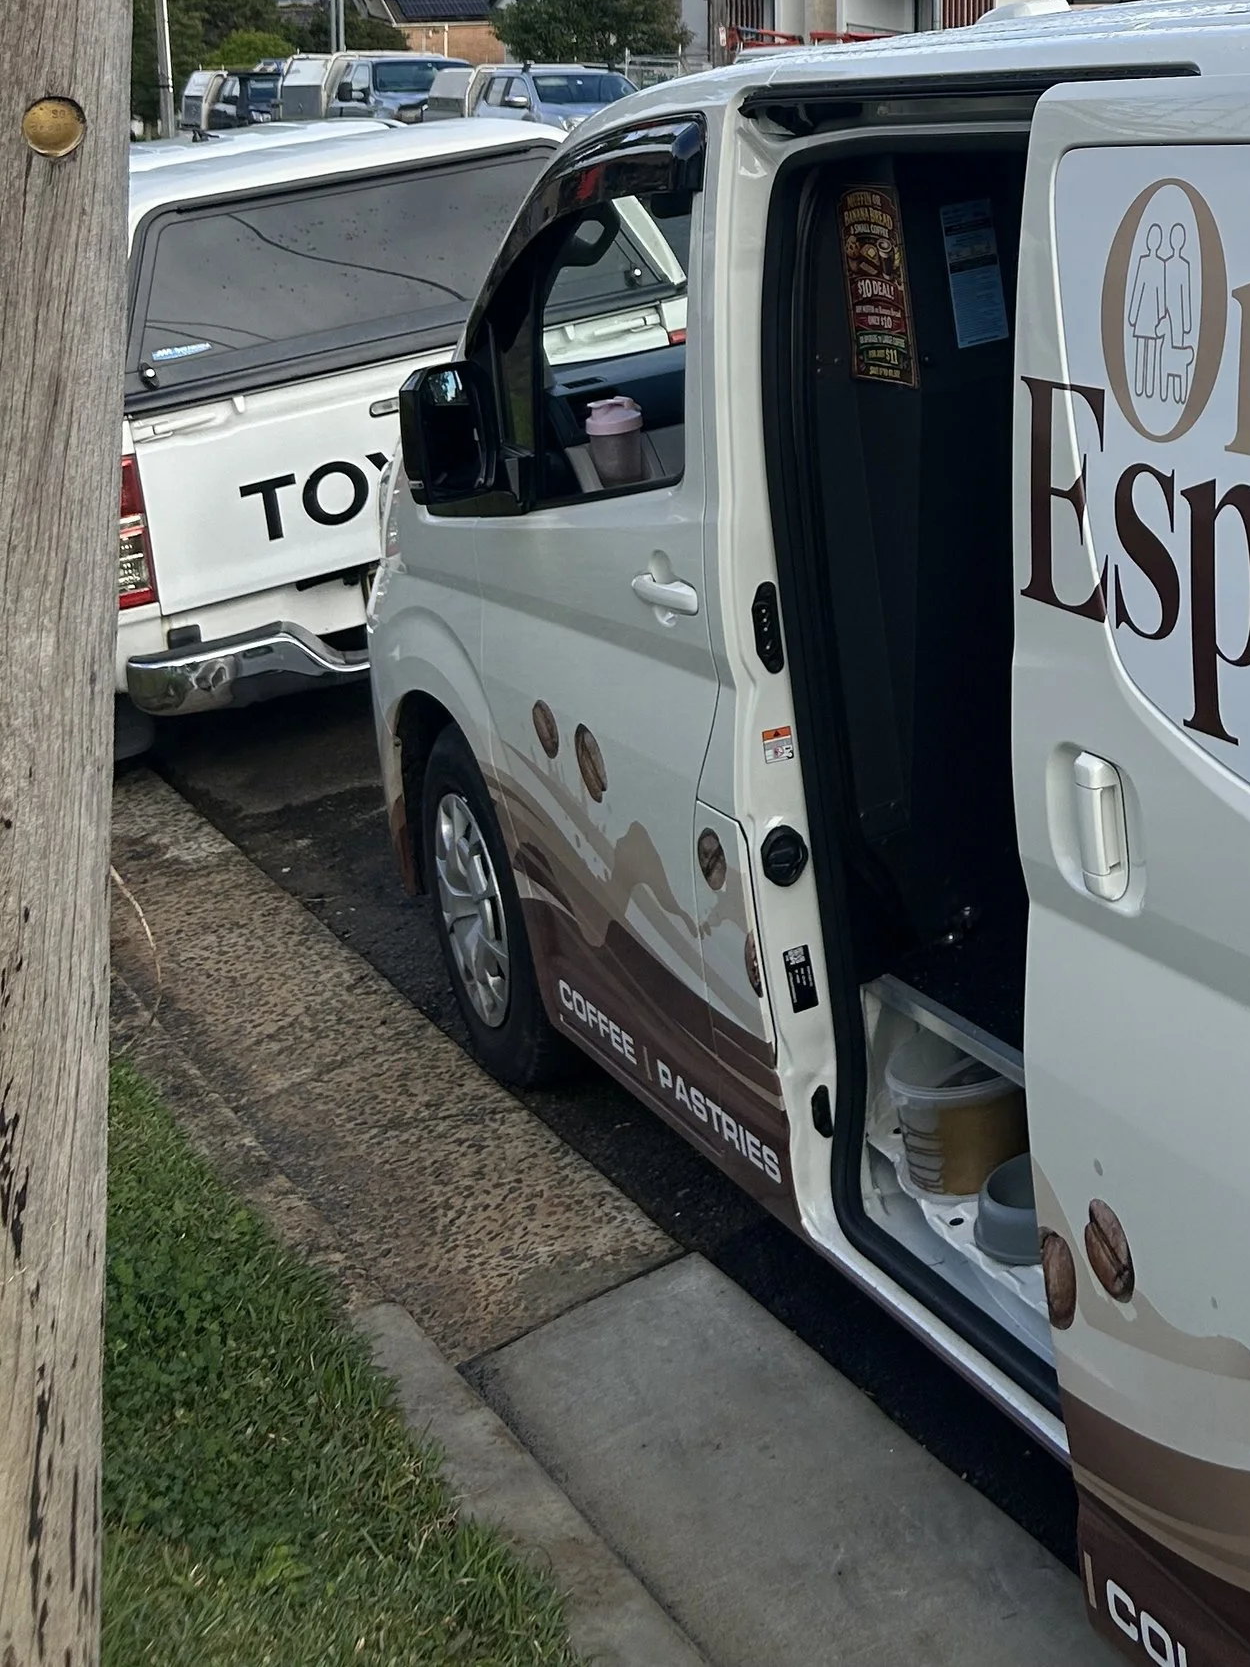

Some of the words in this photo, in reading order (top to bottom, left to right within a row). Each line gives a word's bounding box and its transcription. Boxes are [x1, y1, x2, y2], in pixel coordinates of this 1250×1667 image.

[844, 207, 869, 227] BANANA
[869, 207, 893, 231] BREAD
[854, 223, 870, 234] SMALL
[870, 224, 889, 238] COFFEE
[858, 279, 872, 298] $10
[872, 280, 894, 300] DEAL!
[886, 348, 898, 365] $11
[239, 452, 389, 542] TO
[559, 979, 637, 1065] COFFEE
[657, 1059, 782, 1184] PASTRIES
